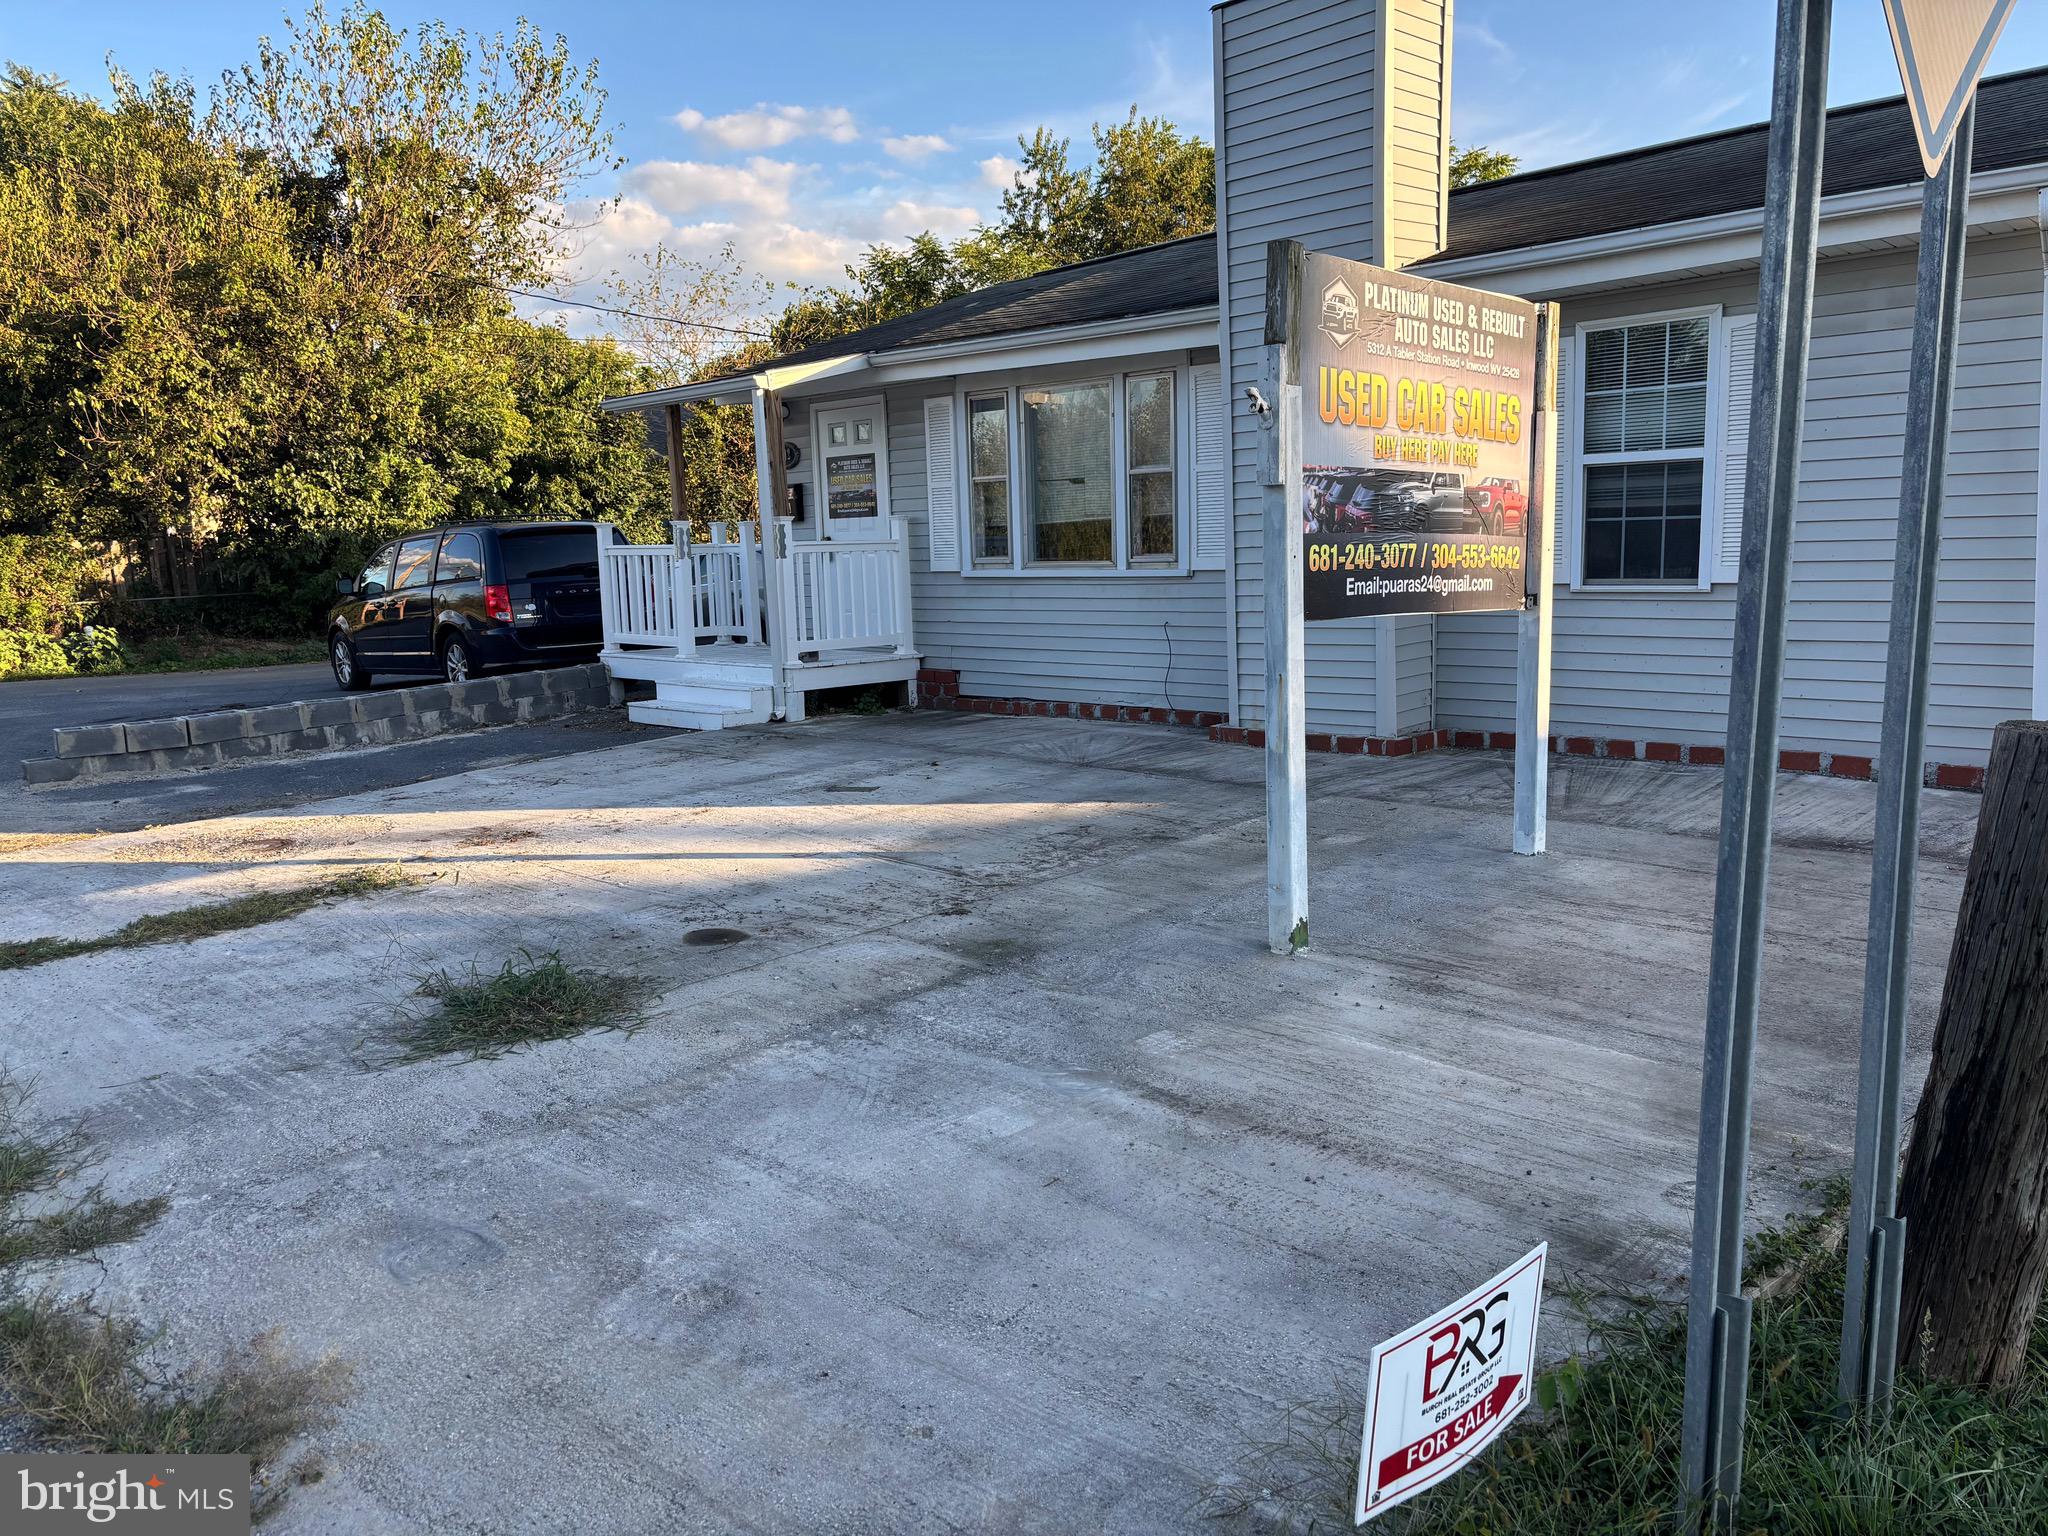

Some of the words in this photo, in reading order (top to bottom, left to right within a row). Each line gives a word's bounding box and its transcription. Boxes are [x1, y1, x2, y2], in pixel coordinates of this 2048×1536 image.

[1365, 281, 1428, 318] PLATINUM
[1434, 297, 1463, 325] USED
[1468, 305, 1478, 329] &
[1482, 308, 1525, 338] REBUILT
[1367, 342, 1384, 355] 5312
[1386, 346, 1392, 357] A
[1393, 346, 1415, 360] Tabler
[1417, 351, 1441, 365] Station
[1443, 356, 1460, 368] Road
[1466, 360, 1489, 373] Inwood
[1490, 364, 1500, 375] WV
[1395, 318, 1428, 346] AUTO
[1433, 325, 1469, 354] SALES
[1474, 333, 1494, 358] LLC
[1320, 366, 1388, 429] USED
[1397, 378, 1447, 434] CAR
[1454, 387, 1520, 444] SALES
[1374, 434, 1397, 460] BUY
[1401, 439, 1427, 463] HERE
[1431, 441, 1451, 465] PAY
[1454, 442, 1478, 467] HERE
[1309, 544, 1417, 572] 681-240-3077
[1420, 543, 1428, 568] /
[1432, 544, 1520, 569] 304-553-6642
[1346, 575, 1492, 598] Email:puaras24@gmail.com
[1423, 1292, 1508, 1404] BRG
[1422, 1398, 1442, 1416] BURCH
[1444, 1391, 1457, 1403] REAL
[1459, 1377, 1476, 1393] ESTATE
[1478, 1363, 1493, 1380] GROUP
[1435, 1375, 1493, 1423] 681-252-3002
[1407, 1430, 1448, 1470] FOR
[1454, 1394, 1492, 1442] SALE
